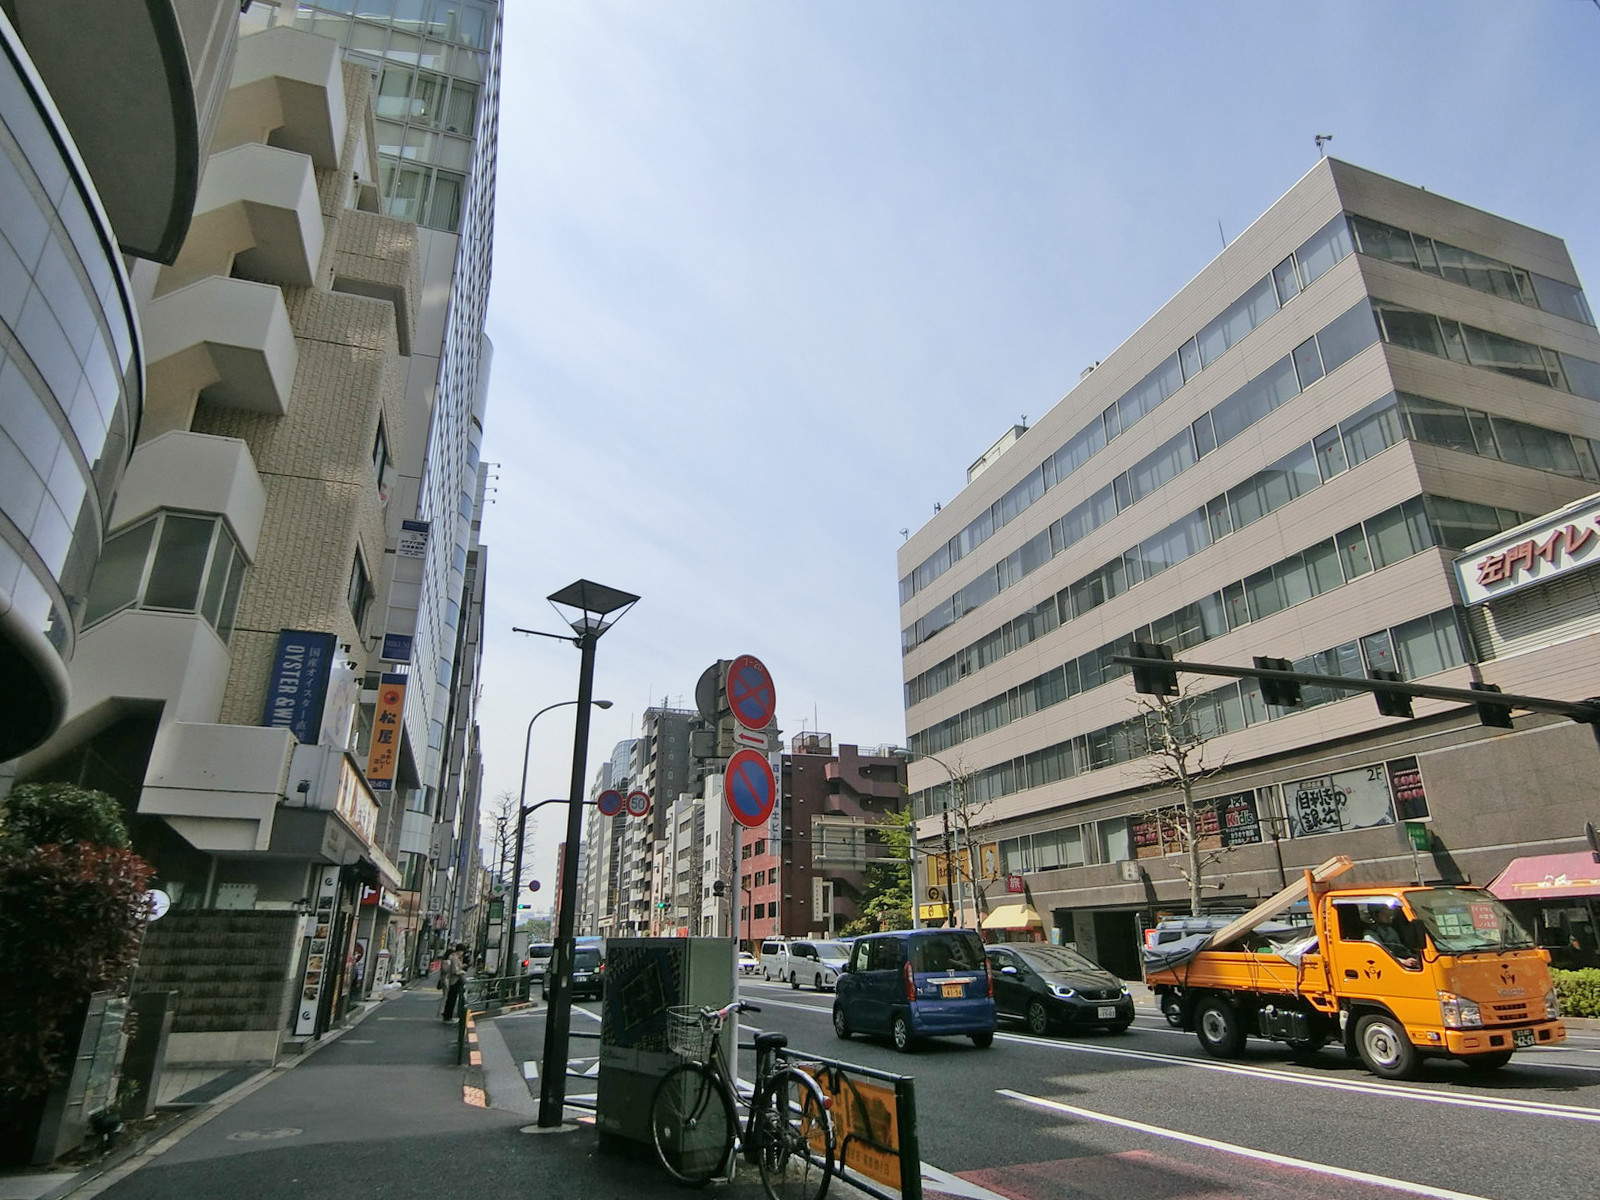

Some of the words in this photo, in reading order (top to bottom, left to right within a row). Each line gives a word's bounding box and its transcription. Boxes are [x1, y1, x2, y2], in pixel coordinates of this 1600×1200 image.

[1476, 514, 1600, 586] 左門イレ
[278, 645, 305, 693] OYSTER
[743, 657, 763, 672] 7-20
[378, 710, 397, 744] 松屋
[1367, 767, 1382, 781] 2F
[370, 780, 388, 789] 24h
[631, 798, 645, 810] 50
[1299, 786, 1347, 810] 目利きの
[1302, 807, 1338, 830] 銀次
[1009, 877, 1021, 888] 旅
